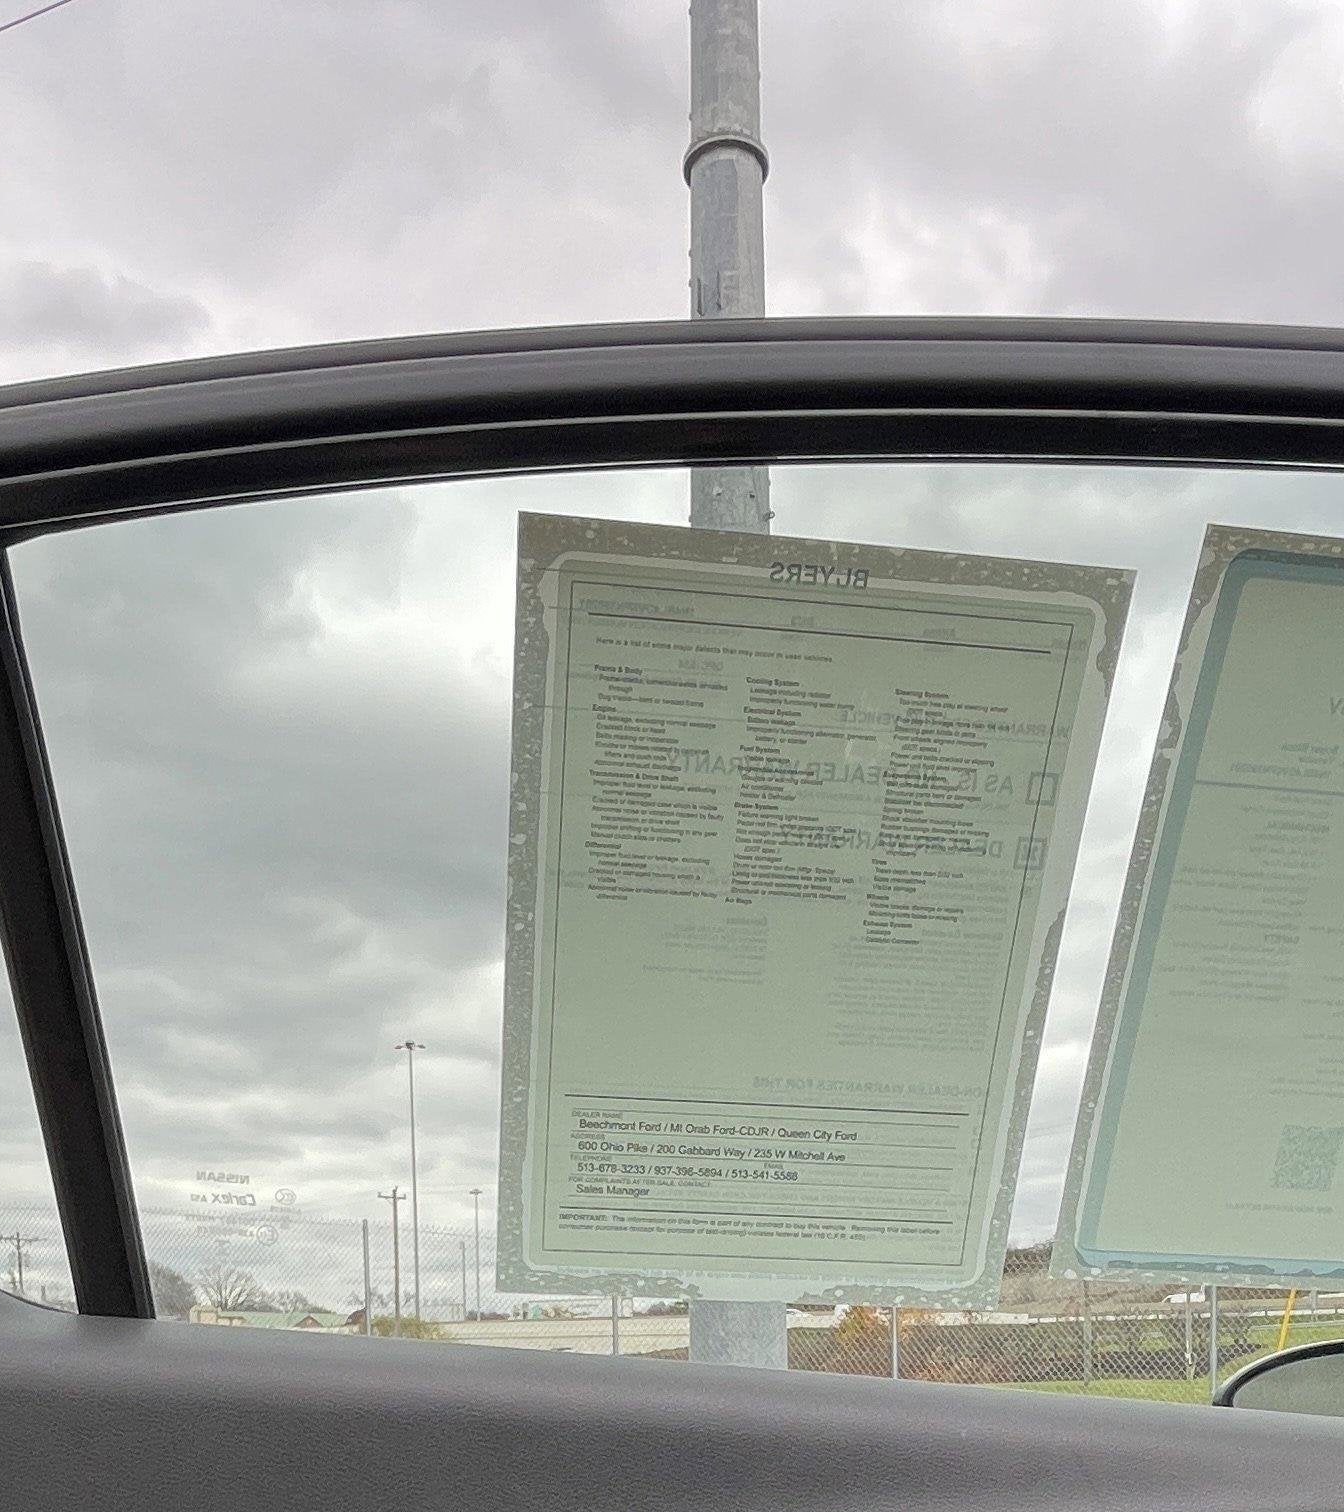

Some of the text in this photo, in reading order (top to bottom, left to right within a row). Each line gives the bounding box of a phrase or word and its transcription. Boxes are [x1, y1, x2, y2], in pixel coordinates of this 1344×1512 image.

[579, 1119, 635, 1129] Beechmont
[638, 1121, 661, 1131] Ford
[685, 1124, 710, 1133] Orab
[713, 1125, 769, 1135] Ford-CDJR
[777, 1128, 810, 1137] Queen
[812, 1129, 832, 1141] City
[834, 1130, 857, 1139] Ford
[578, 1141, 597, 1150] 600
[600, 1142, 624, 1151] Ohio
[626, 1143, 648, 1152] Pike
[656, 1144, 675, 1153] 200
[678, 1145, 720, 1155] Gabbard
[723, 1147, 745, 1159] Way
[753, 1148, 772, 1158] 235
[774, 1149, 786, 1158] W
[787, 1150, 824, 1160] Mitchell
[826, 1152, 846, 1161] Ave
[576, 1184, 649, 1197] Sales Manager
